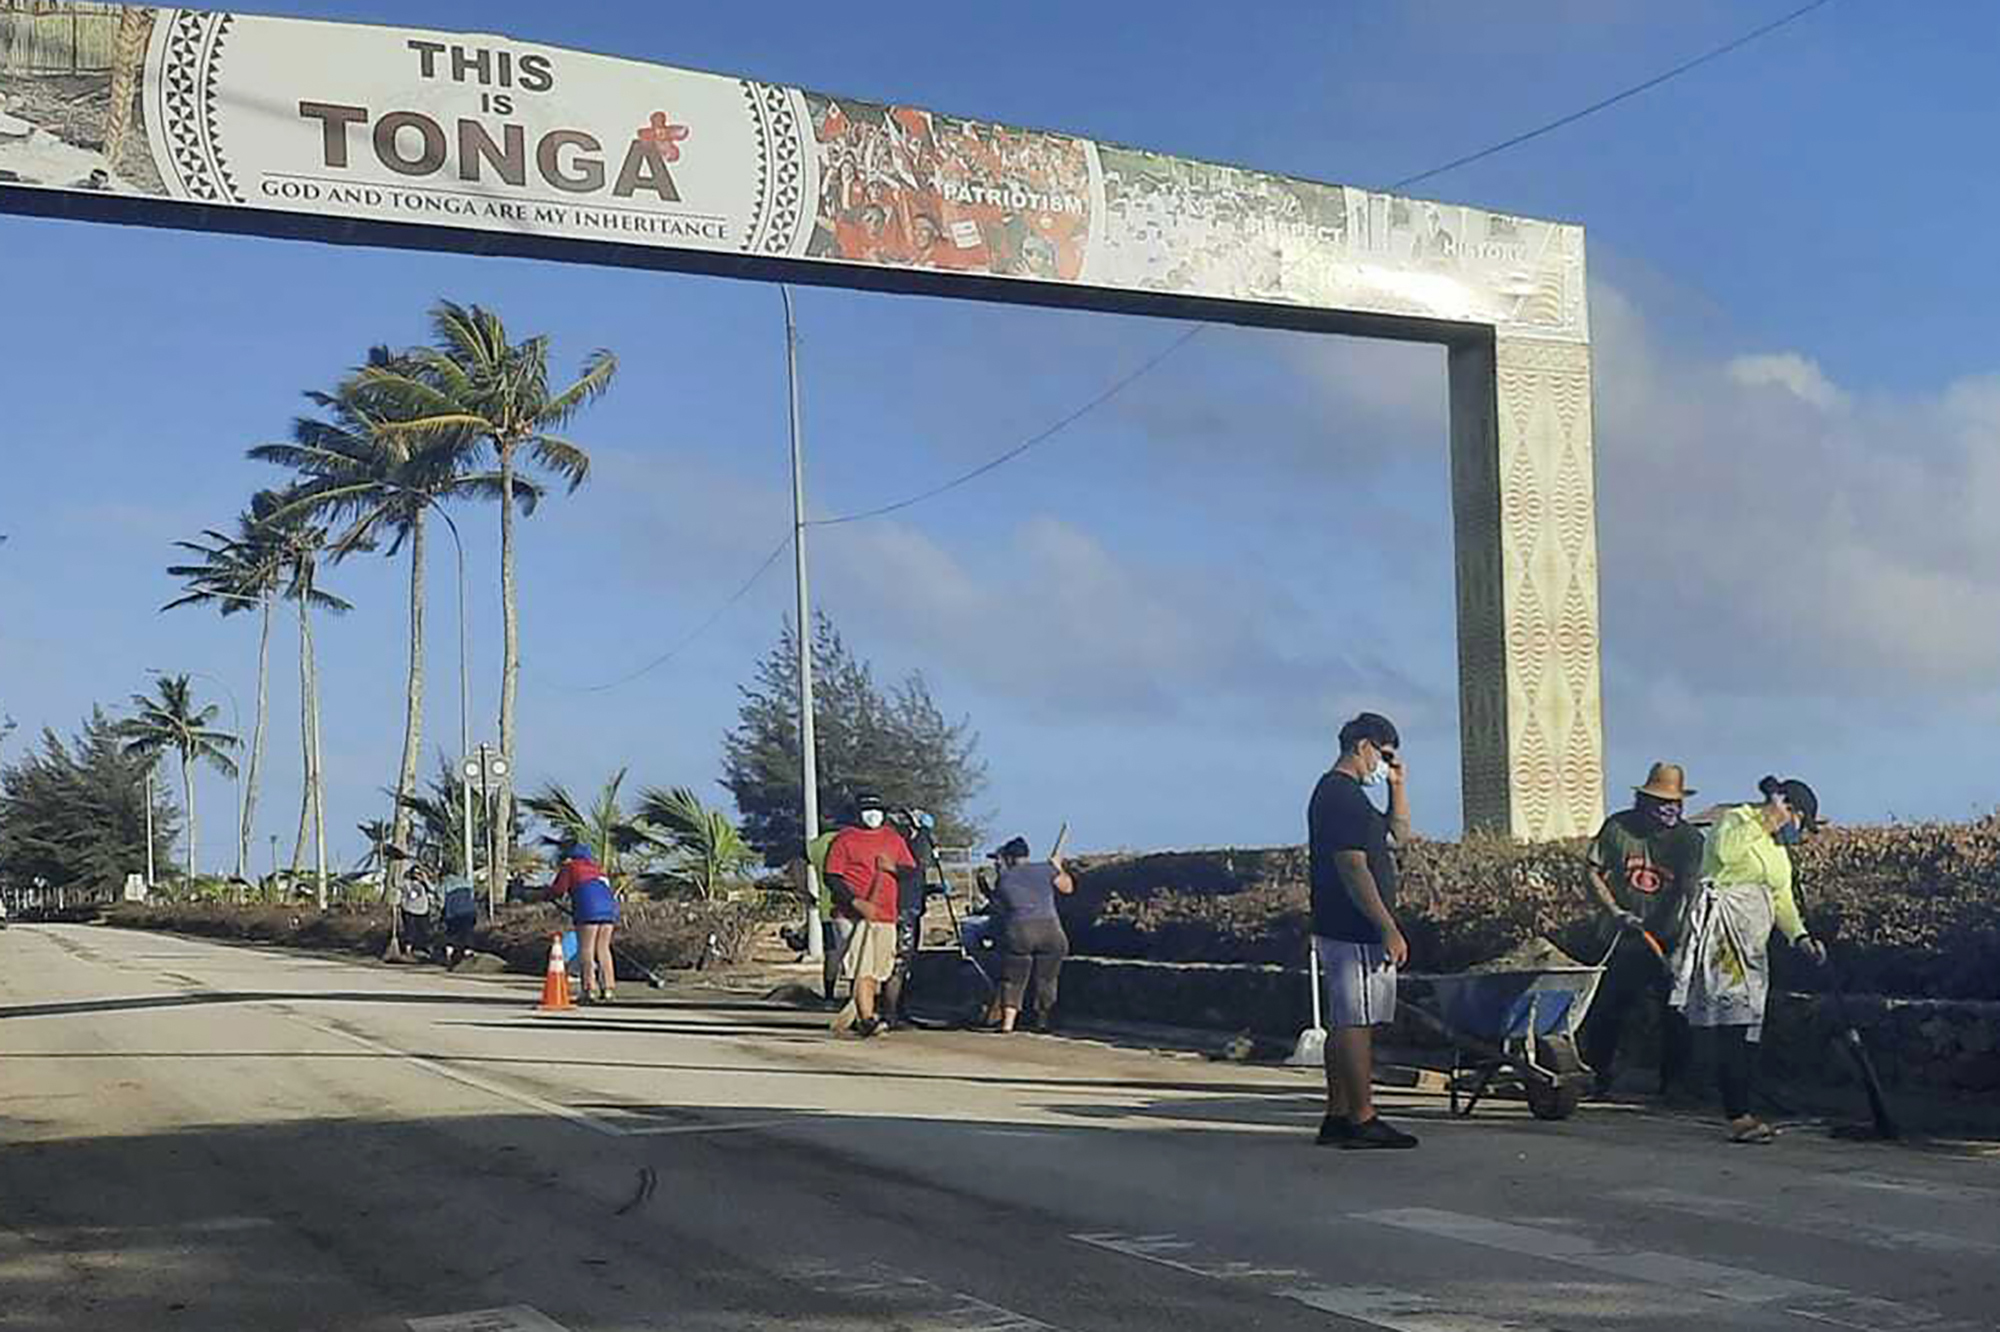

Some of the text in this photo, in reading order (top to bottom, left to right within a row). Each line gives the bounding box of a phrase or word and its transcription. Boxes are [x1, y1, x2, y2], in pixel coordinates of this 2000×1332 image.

[408, 40, 553, 92] THIS
[481, 92, 514, 115] IS
[299, 101, 682, 202] TONGA
[261, 181, 729, 239] GOD AND TONGA ARE MY INHERITANCE
[943, 183, 1082, 215] PATRIOTISM
